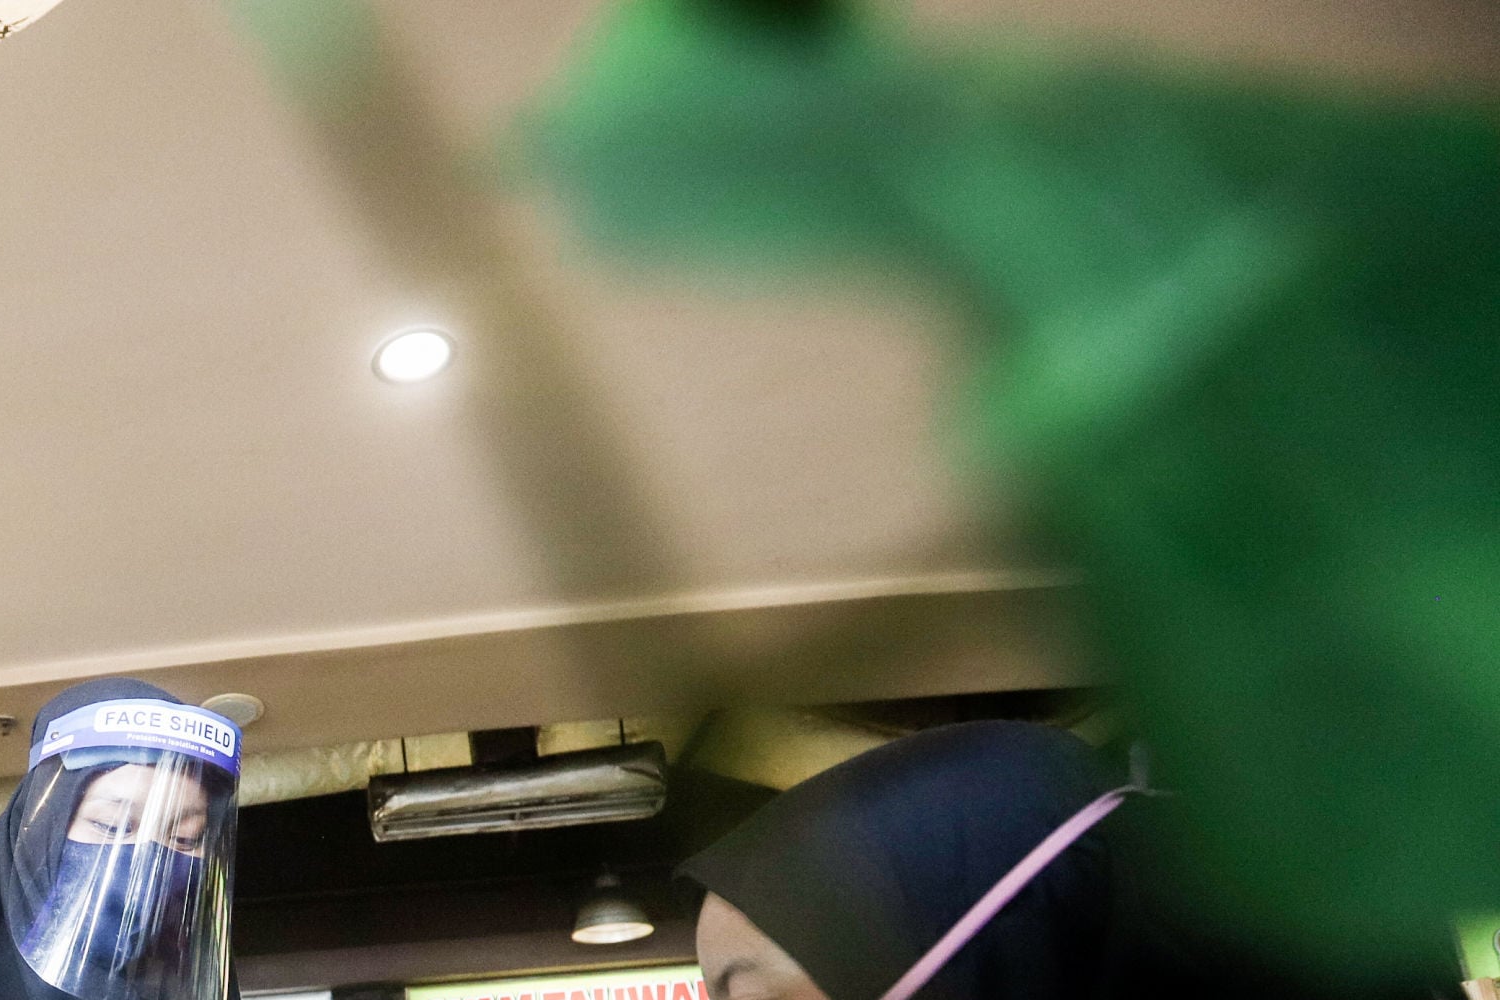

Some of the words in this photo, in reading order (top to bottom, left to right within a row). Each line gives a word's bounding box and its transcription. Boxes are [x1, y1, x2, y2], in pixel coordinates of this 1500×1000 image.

[104, 710, 162, 727] FACE
[169, 715, 231, 748] SHIELD
[126, 732, 167, 745] Protective
[167, 737, 200, 752] Isolation
[200, 746, 216, 758] Mask
